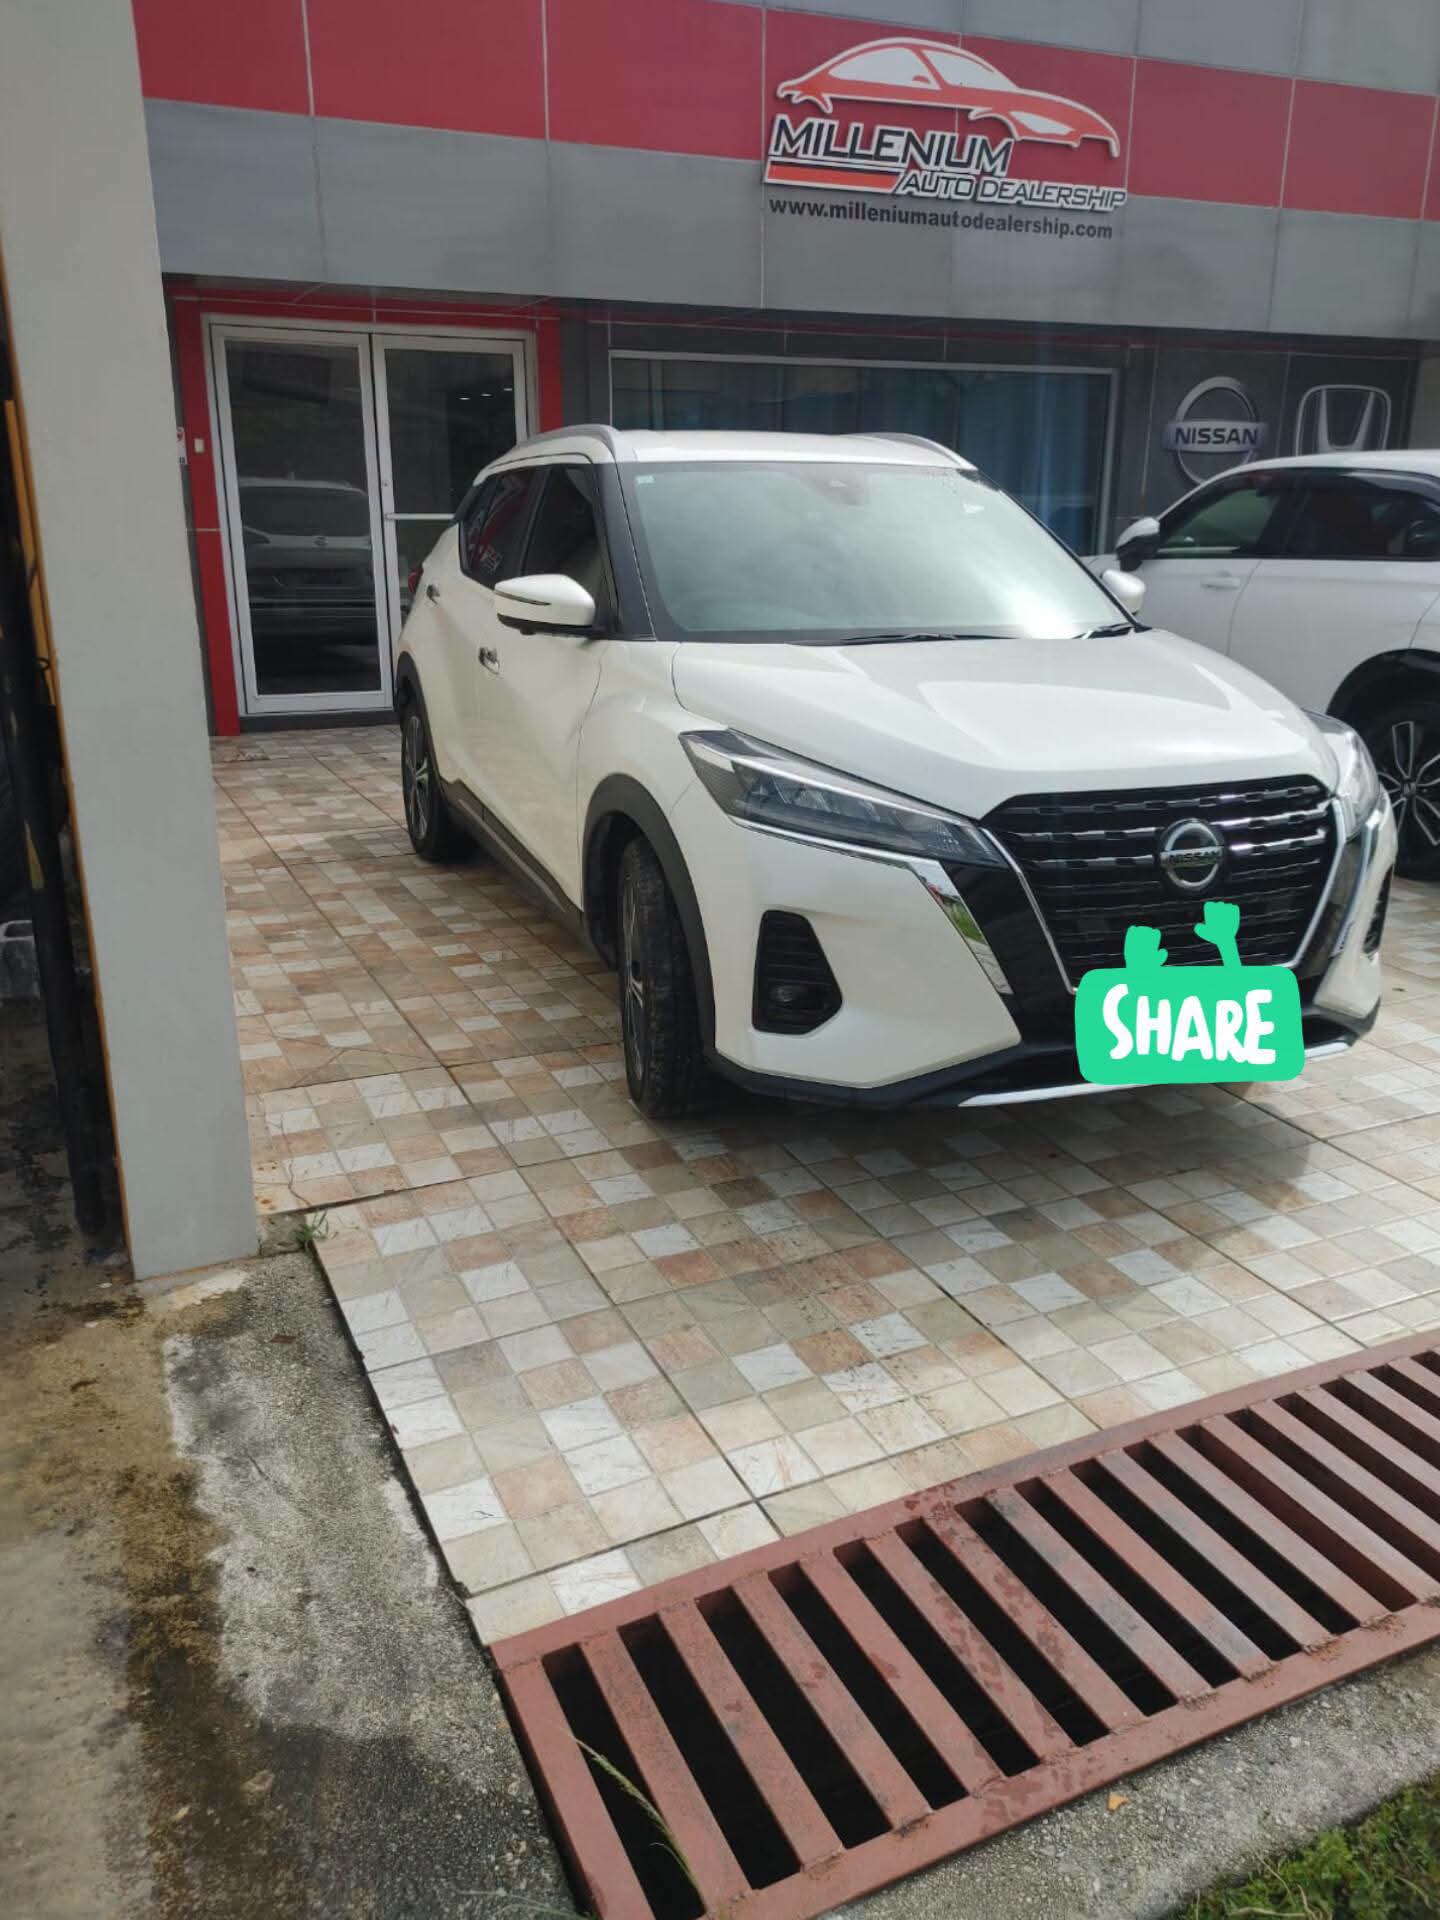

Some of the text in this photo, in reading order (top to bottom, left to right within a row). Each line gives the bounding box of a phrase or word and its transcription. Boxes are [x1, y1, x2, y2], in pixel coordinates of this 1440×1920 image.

[772, 117, 1011, 176] MILLENIUM
[900, 171, 1128, 210] AUTO DEALERSHIP
[768, 198, 1114, 241] www.milleniumautodealership.com
[1174, 427, 1259, 446] NISSAN
[1167, 848, 1220, 865] NISSAN
